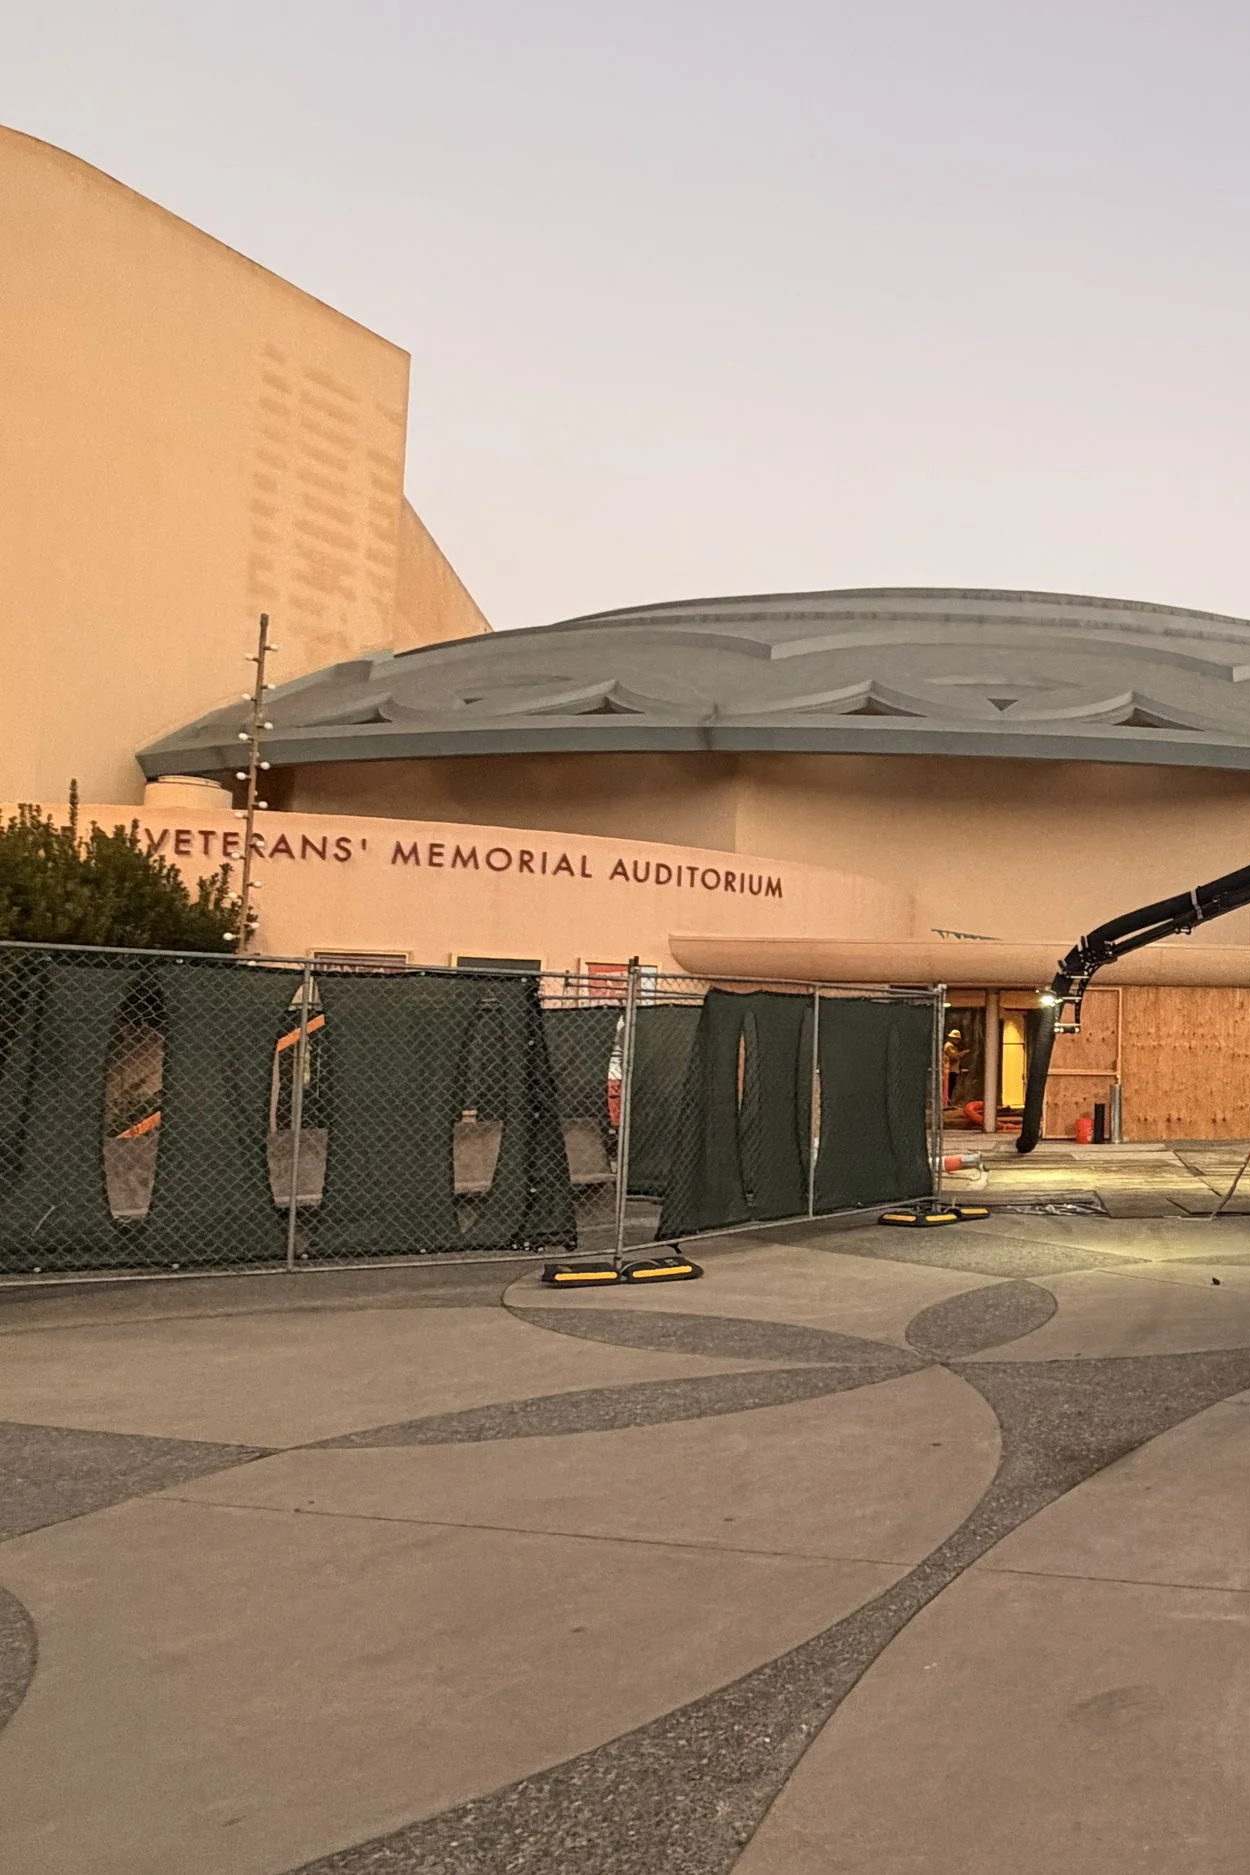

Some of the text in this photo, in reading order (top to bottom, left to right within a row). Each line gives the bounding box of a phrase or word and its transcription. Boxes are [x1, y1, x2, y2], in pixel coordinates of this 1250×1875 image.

[144, 827, 784, 899] VETERANS' MEMORIAL AUDITORIUM
